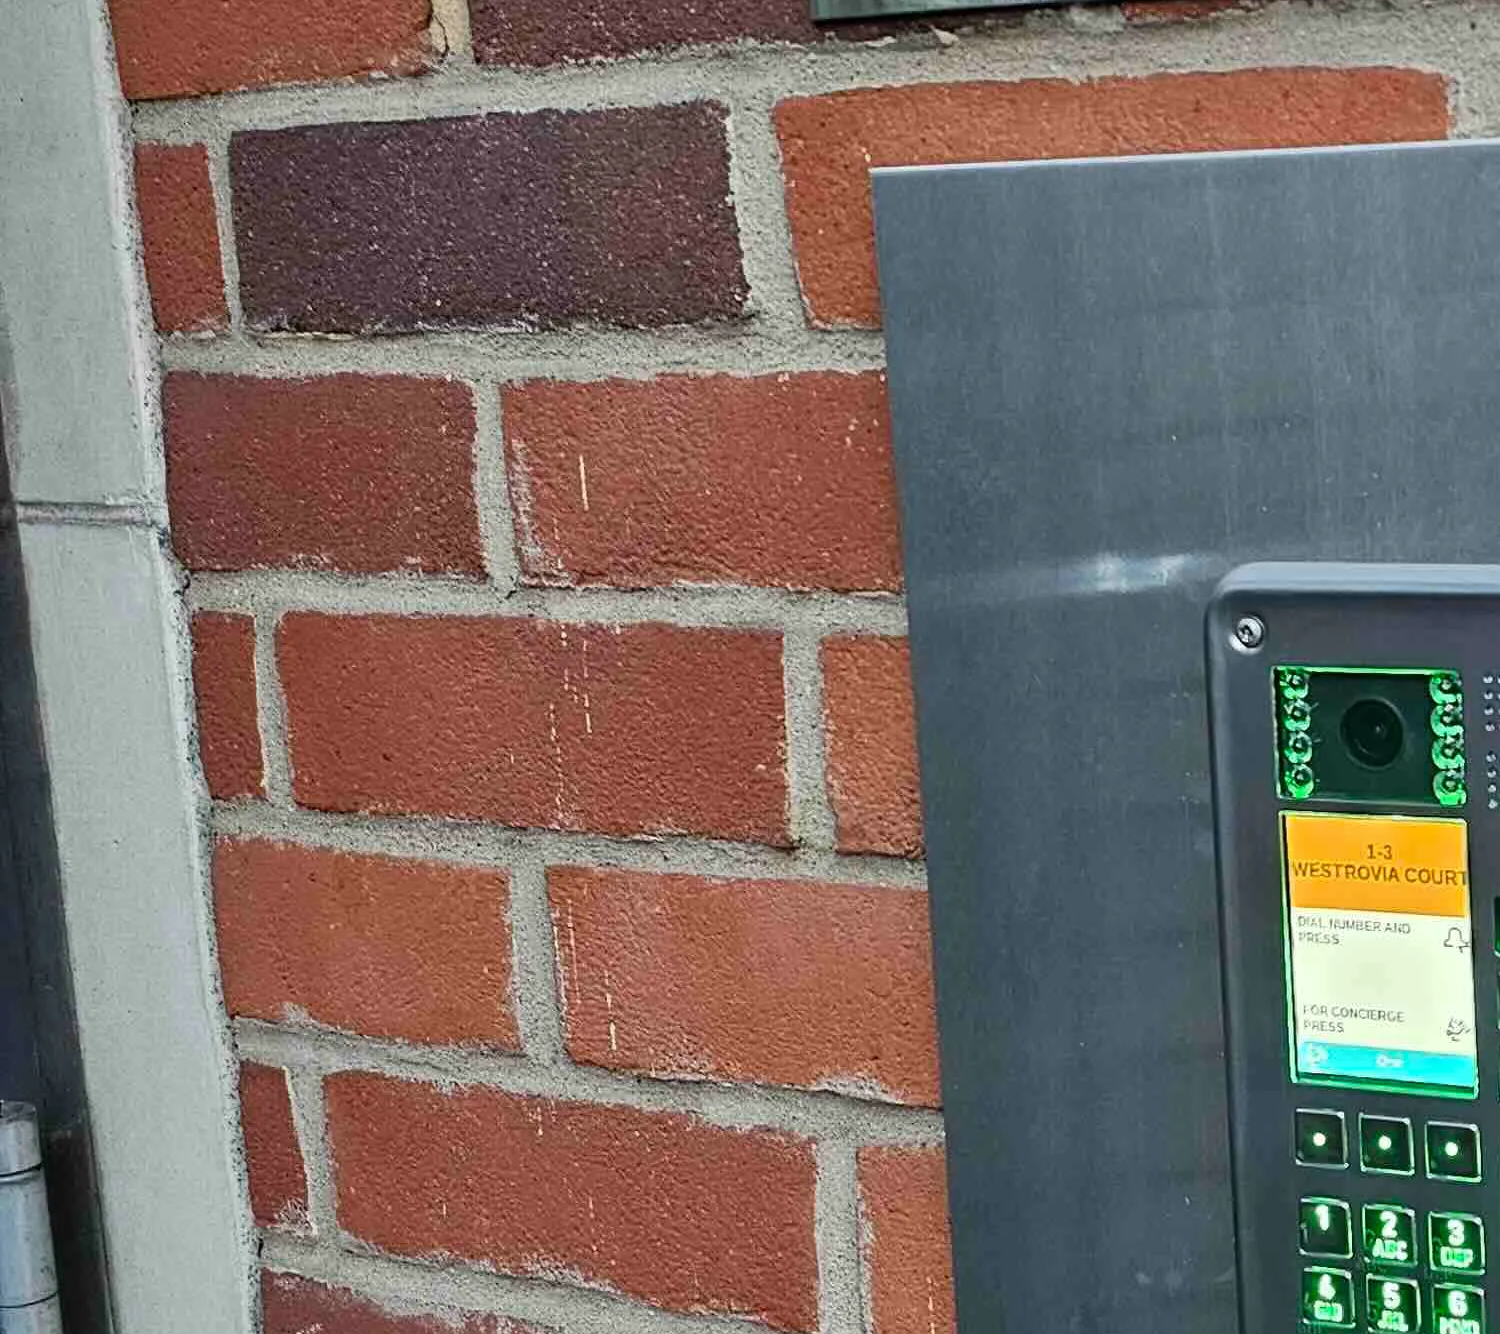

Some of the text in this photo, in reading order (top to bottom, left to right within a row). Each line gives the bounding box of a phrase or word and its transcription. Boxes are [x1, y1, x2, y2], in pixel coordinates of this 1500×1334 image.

[1367, 843, 1393, 860] 1-3
[1293, 861, 1467, 886] WESTROVIA COURT
[1297, 915, 1412, 935] DIAL NUMBER AND
[1298, 931, 1340, 946] PRESS
[1303, 1003, 1405, 1023] FOR CONCIERGE
[1303, 1019, 1345, 1034] PRESS
[1315, 1204, 1330, 1232] 1
[1379, 1210, 1398, 1238] 2
[1447, 1219, 1465, 1246] 3
[1382, 1282, 1400, 1309] 5
[1447, 1290, 1468, 1317] 6
